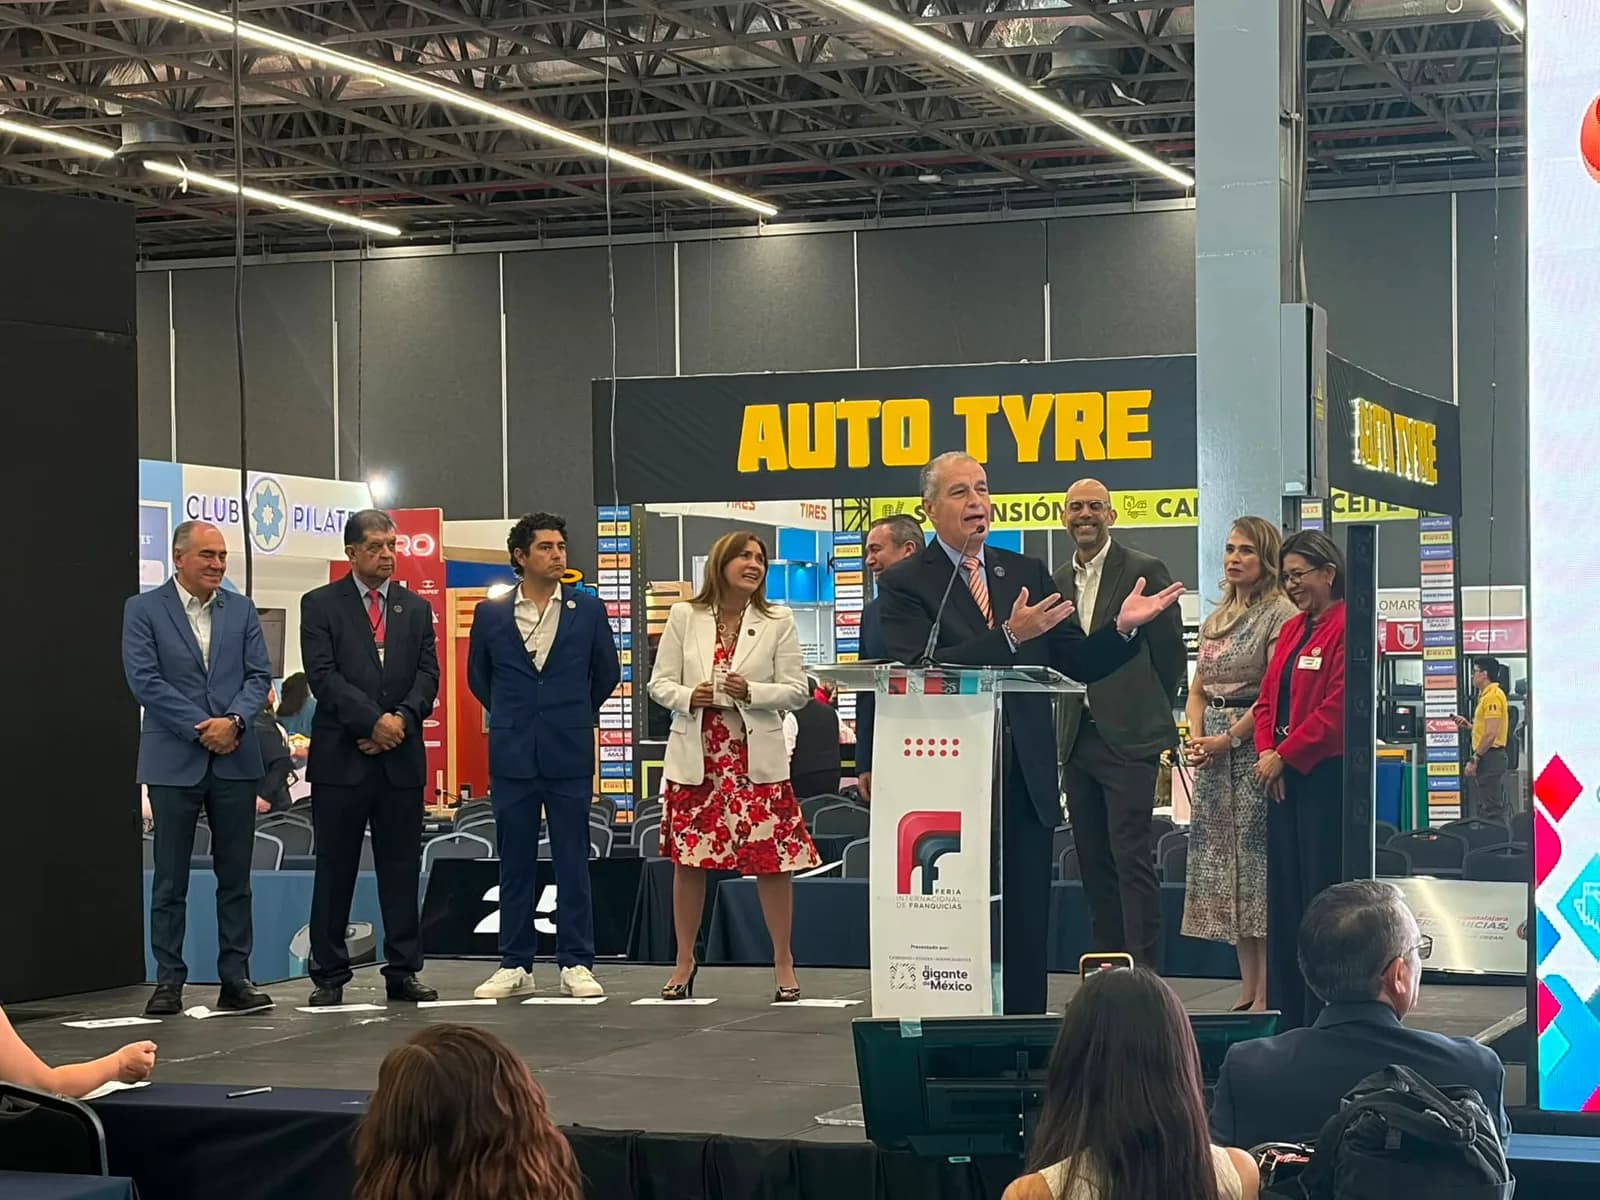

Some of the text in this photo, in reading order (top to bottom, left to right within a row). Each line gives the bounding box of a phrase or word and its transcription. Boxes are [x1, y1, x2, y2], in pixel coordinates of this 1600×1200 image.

[738, 389, 1152, 472] AUTO TYRE
[186, 495, 240, 523] CLUB
[800, 503, 827, 520] TIRES
[922, 968, 968, 980] gigante
[930, 980, 972, 991] México
